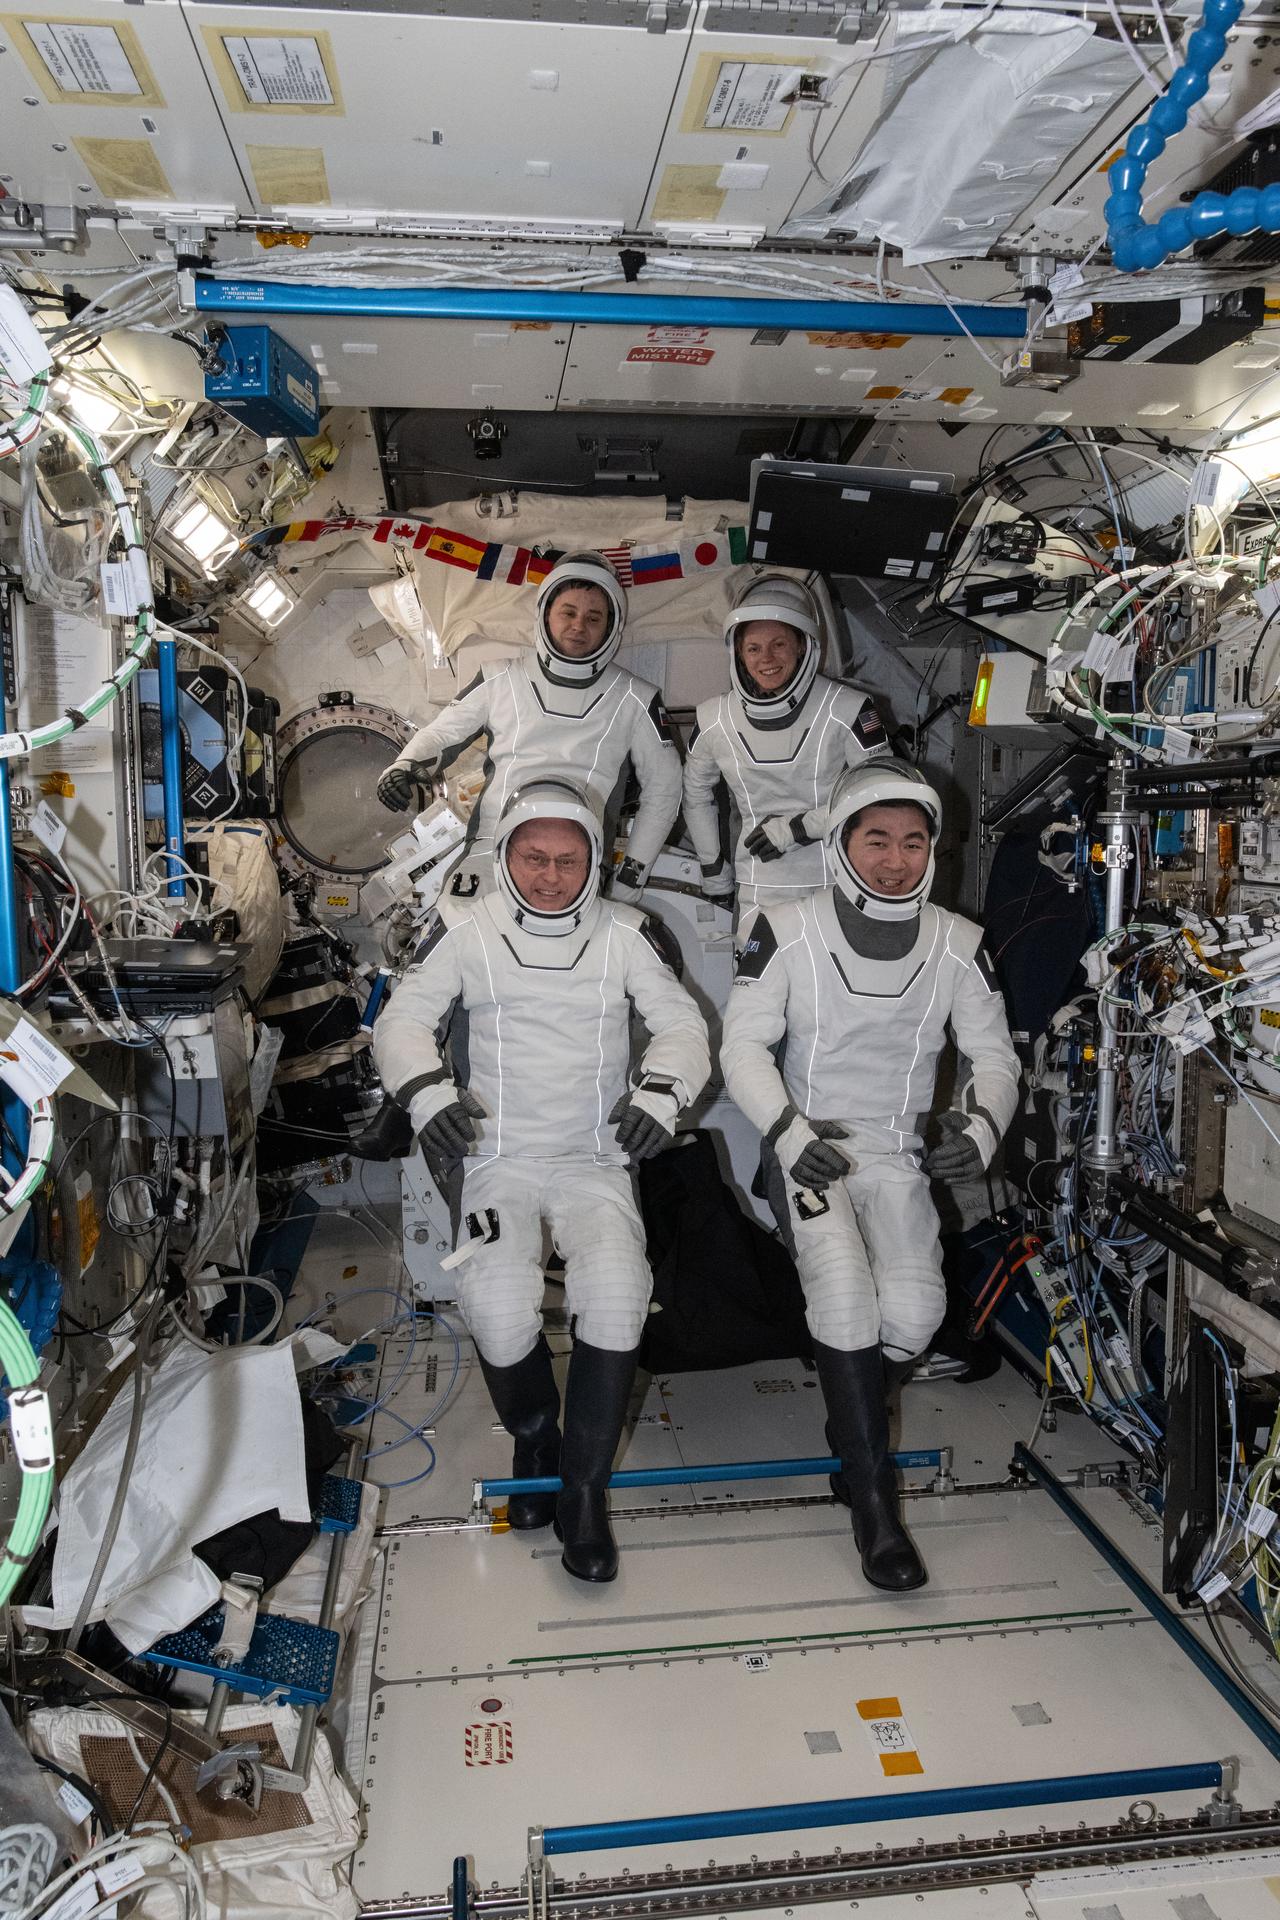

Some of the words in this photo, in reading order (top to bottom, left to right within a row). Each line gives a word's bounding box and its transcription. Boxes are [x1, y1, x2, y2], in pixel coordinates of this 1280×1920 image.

[642, 347, 704, 356] WATER
[675, 354, 709, 363] PFE
[484, 1728, 492, 1742] FIRE
[484, 1742, 493, 1760] PORT
